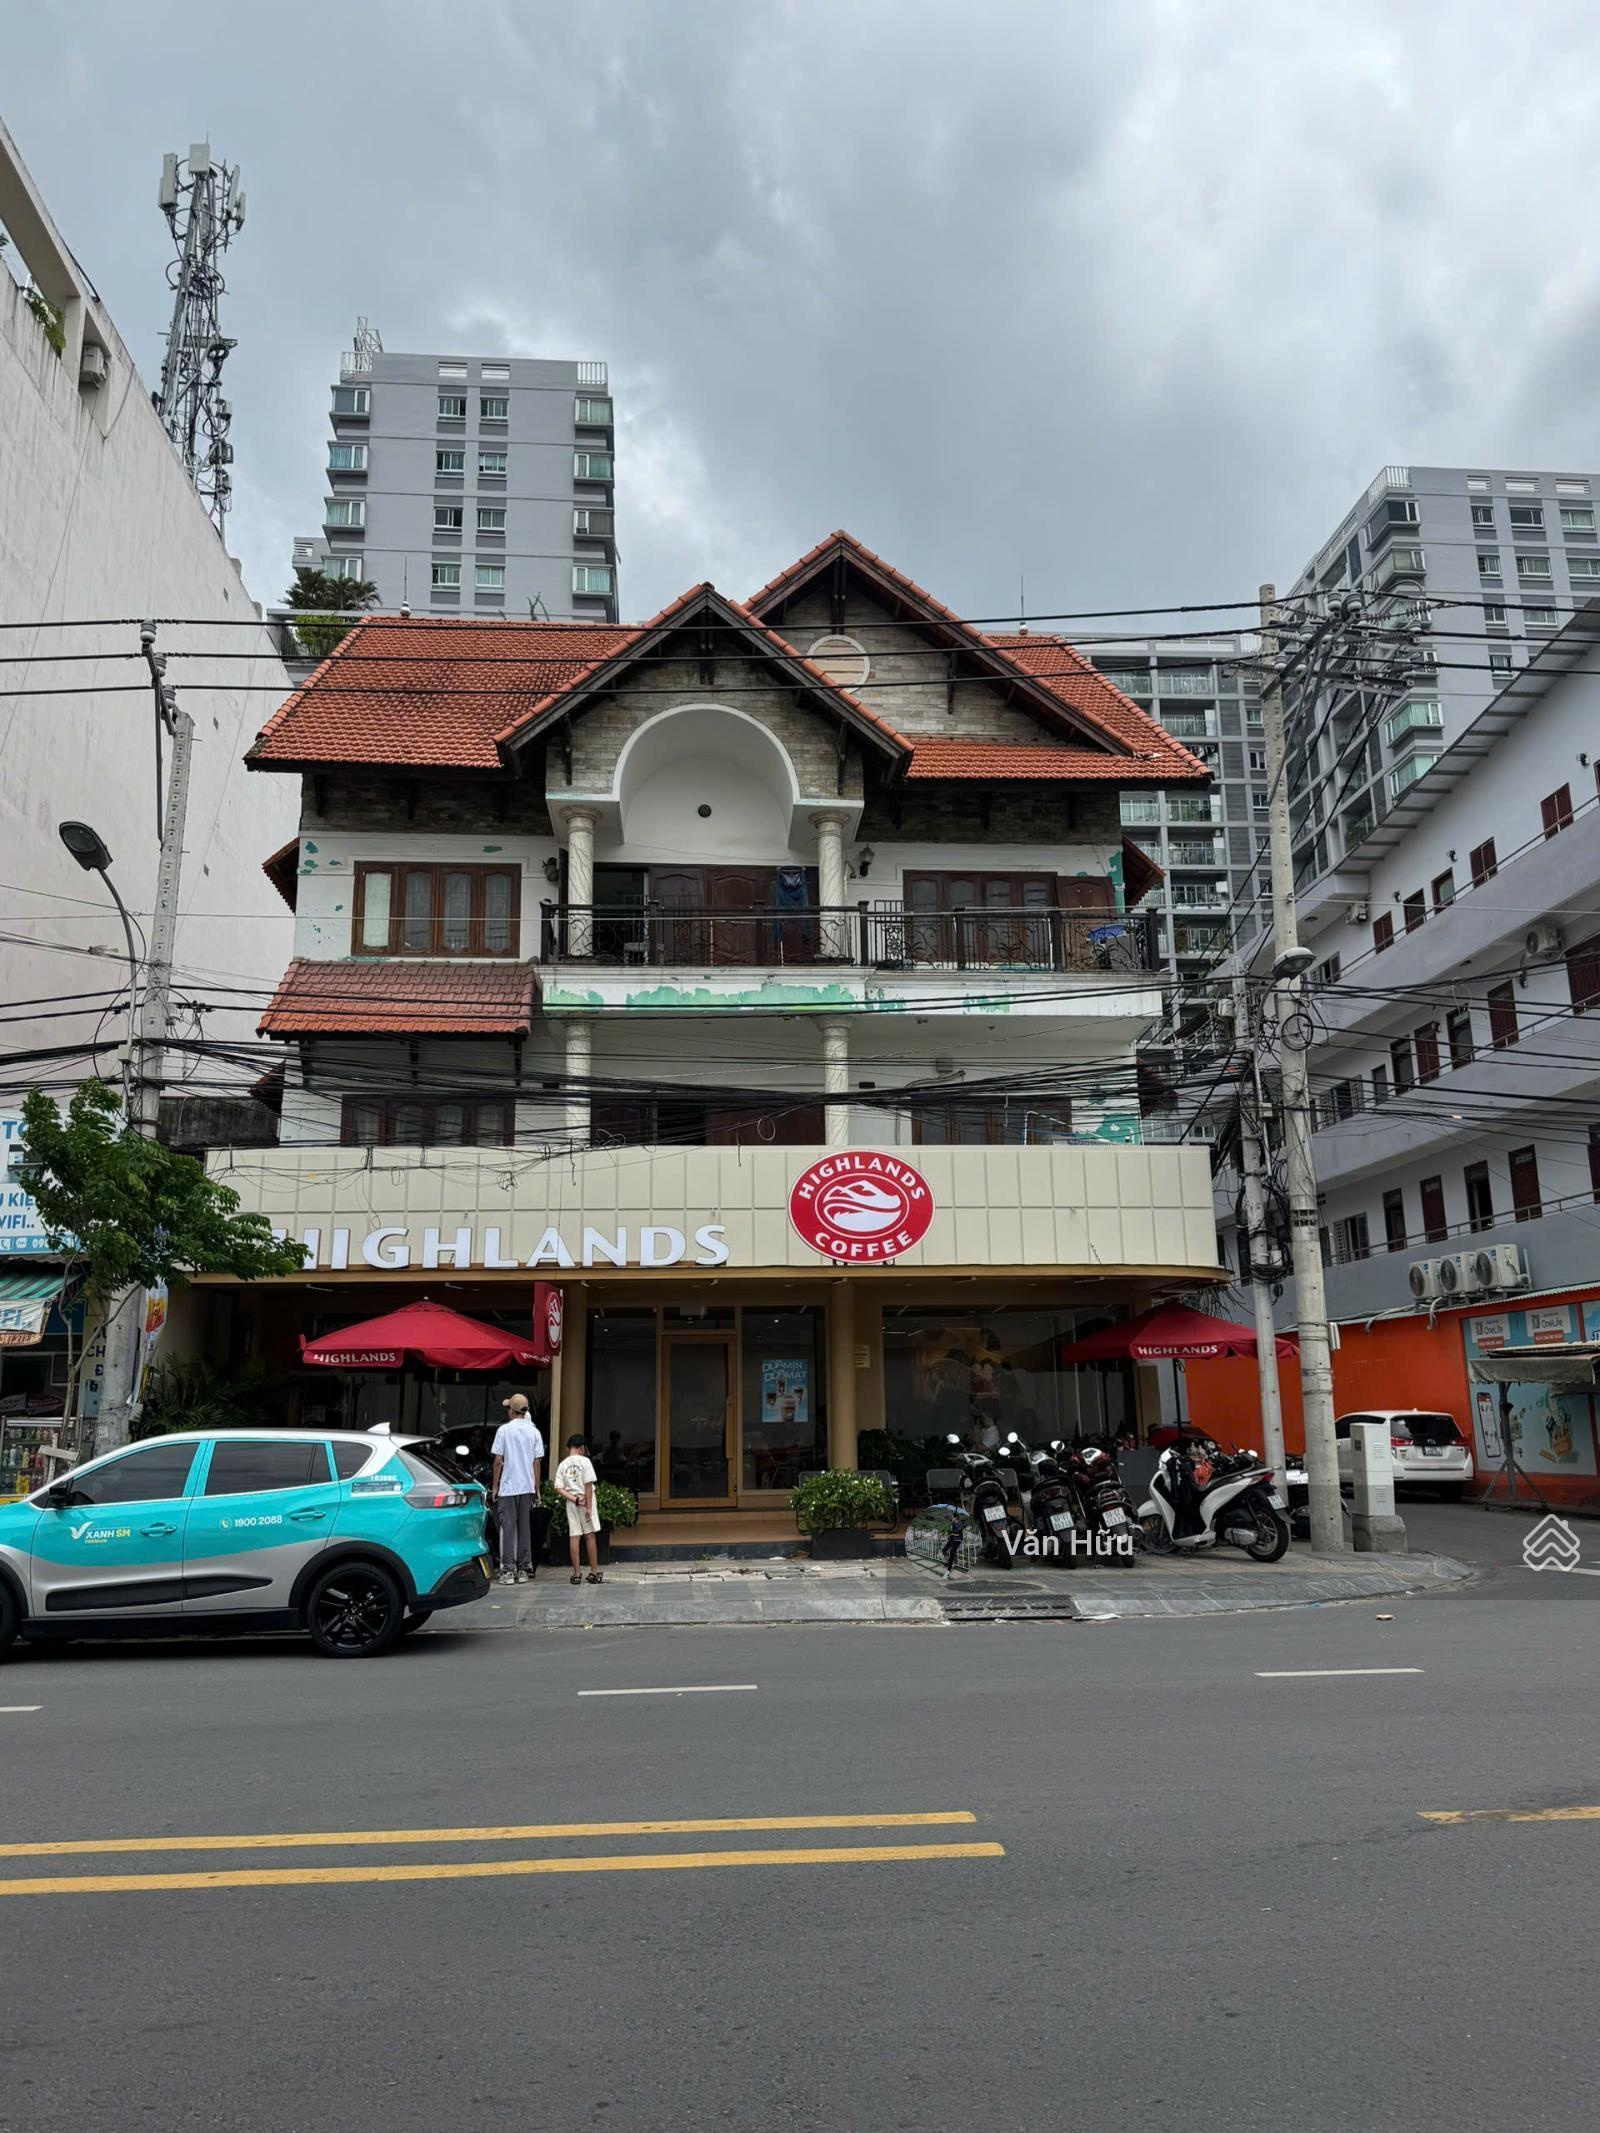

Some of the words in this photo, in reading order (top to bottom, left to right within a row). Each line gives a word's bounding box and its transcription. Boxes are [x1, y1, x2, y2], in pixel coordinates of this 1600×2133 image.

[798, 1156, 925, 1199] HIGHLANDS
[815, 1230, 913, 1257] COFFEE
[1137, 1344, 1218, 1355] HIGHLANDS
[313, 1352, 396, 1364] HIGHLANDS
[235, 1517, 257, 1527] 1900
[258, 1515, 282, 1525] 2088
[86, 1530, 115, 1539] XANH
[116, 1529, 131, 1537] SM
